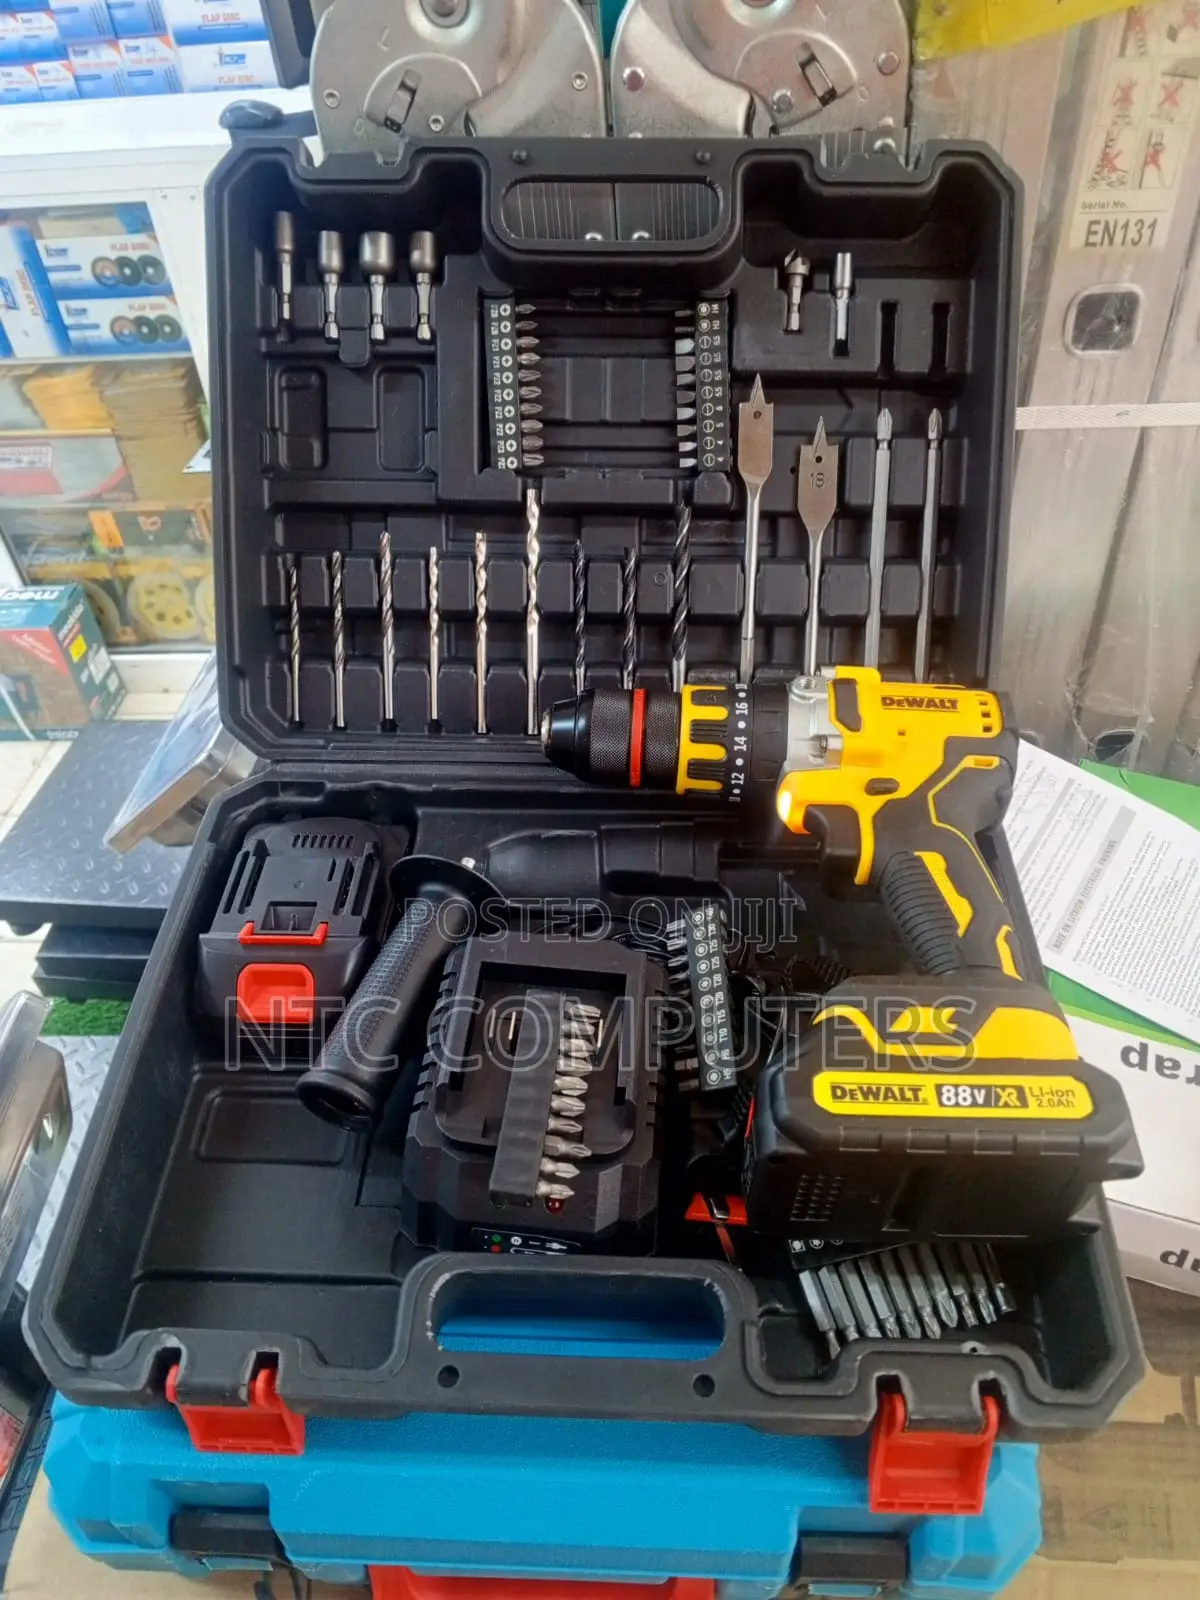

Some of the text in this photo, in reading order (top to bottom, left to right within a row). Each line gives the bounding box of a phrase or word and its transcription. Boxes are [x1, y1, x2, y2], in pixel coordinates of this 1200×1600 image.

[1084, 217, 1158, 247] EN131
[735, 702, 748, 715] 16
[734, 736, 748, 752] 14
[731, 772, 744, 785] 12
[713, 973, 722, 988] T20
[716, 1009, 726, 1024] T15
[718, 1027, 728, 1042] T10
[1036, 1098, 1076, 1108] 2.0Ah
